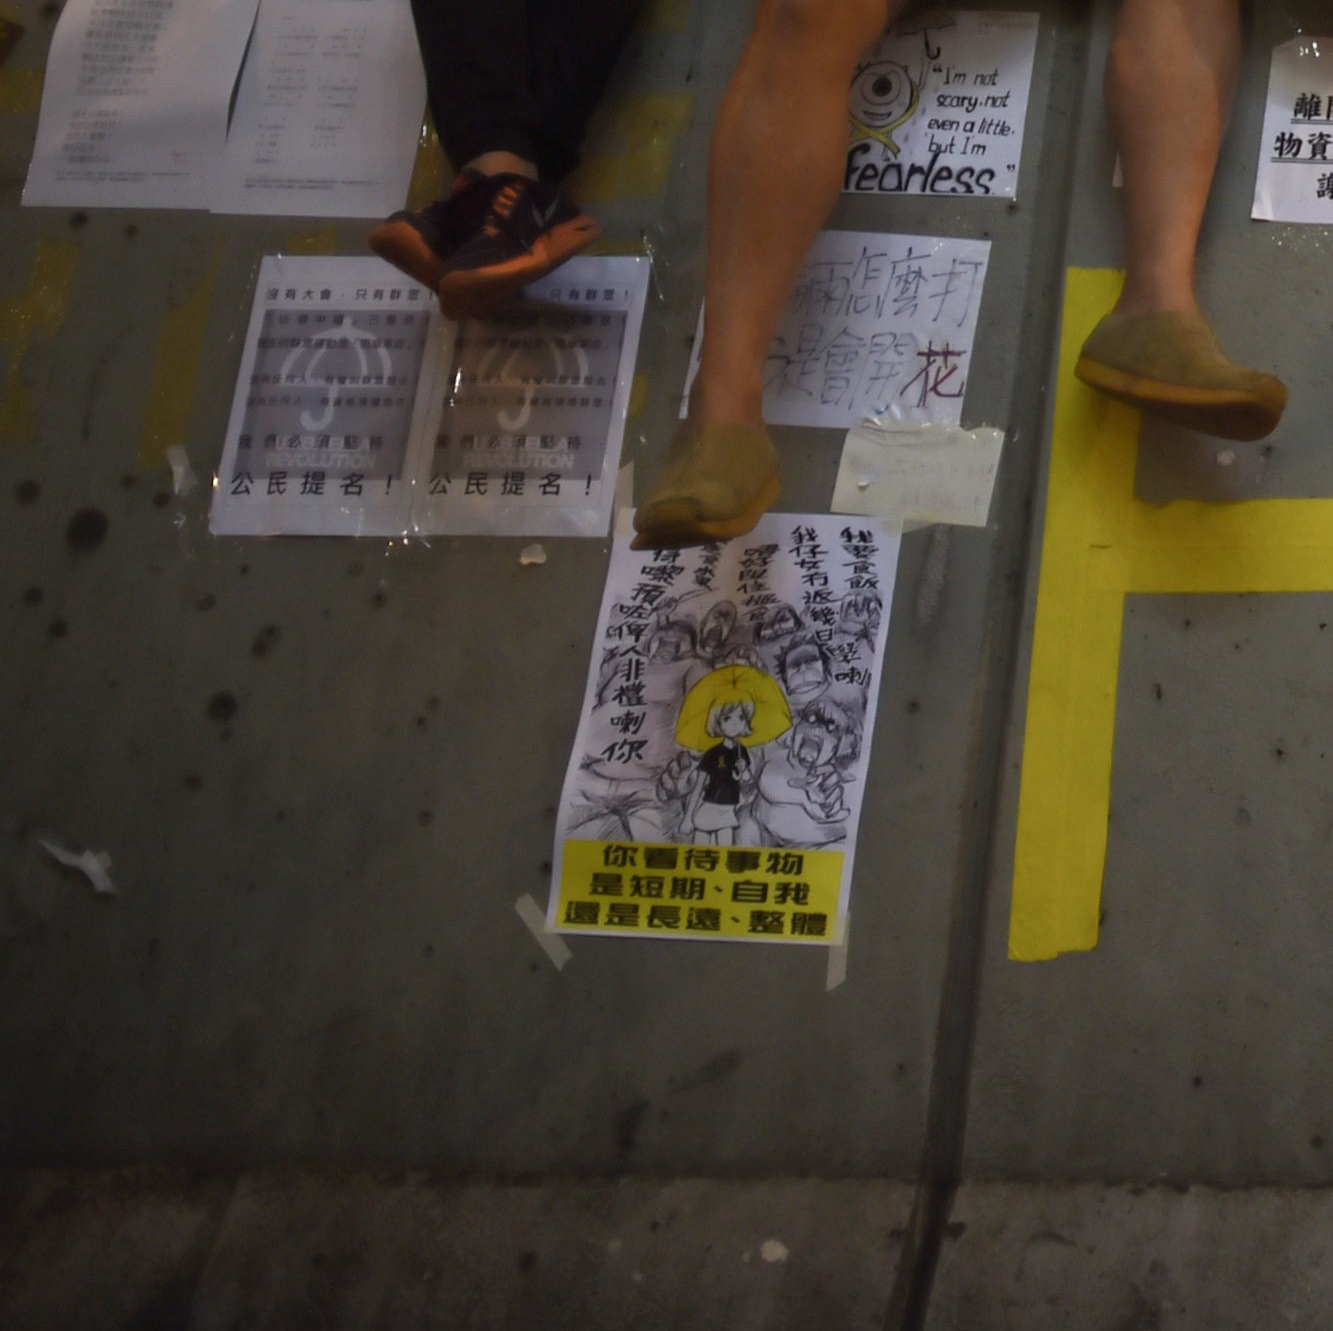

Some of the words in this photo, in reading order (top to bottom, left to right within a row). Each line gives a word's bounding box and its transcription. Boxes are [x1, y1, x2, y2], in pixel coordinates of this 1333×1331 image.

[974, 69, 999, 87] not
[928, 118, 960, 134] even
[963, 119, 976, 134] a
[928, 135, 955, 158] but
[230, 470, 393, 497] 公民提名！
[429, 471, 593, 497] 公民提名！
[601, 843, 805, 877] 你看待事物
[588, 872, 811, 907] 是短期、自我
[562, 899, 829, 938] 還是長遠、整體
